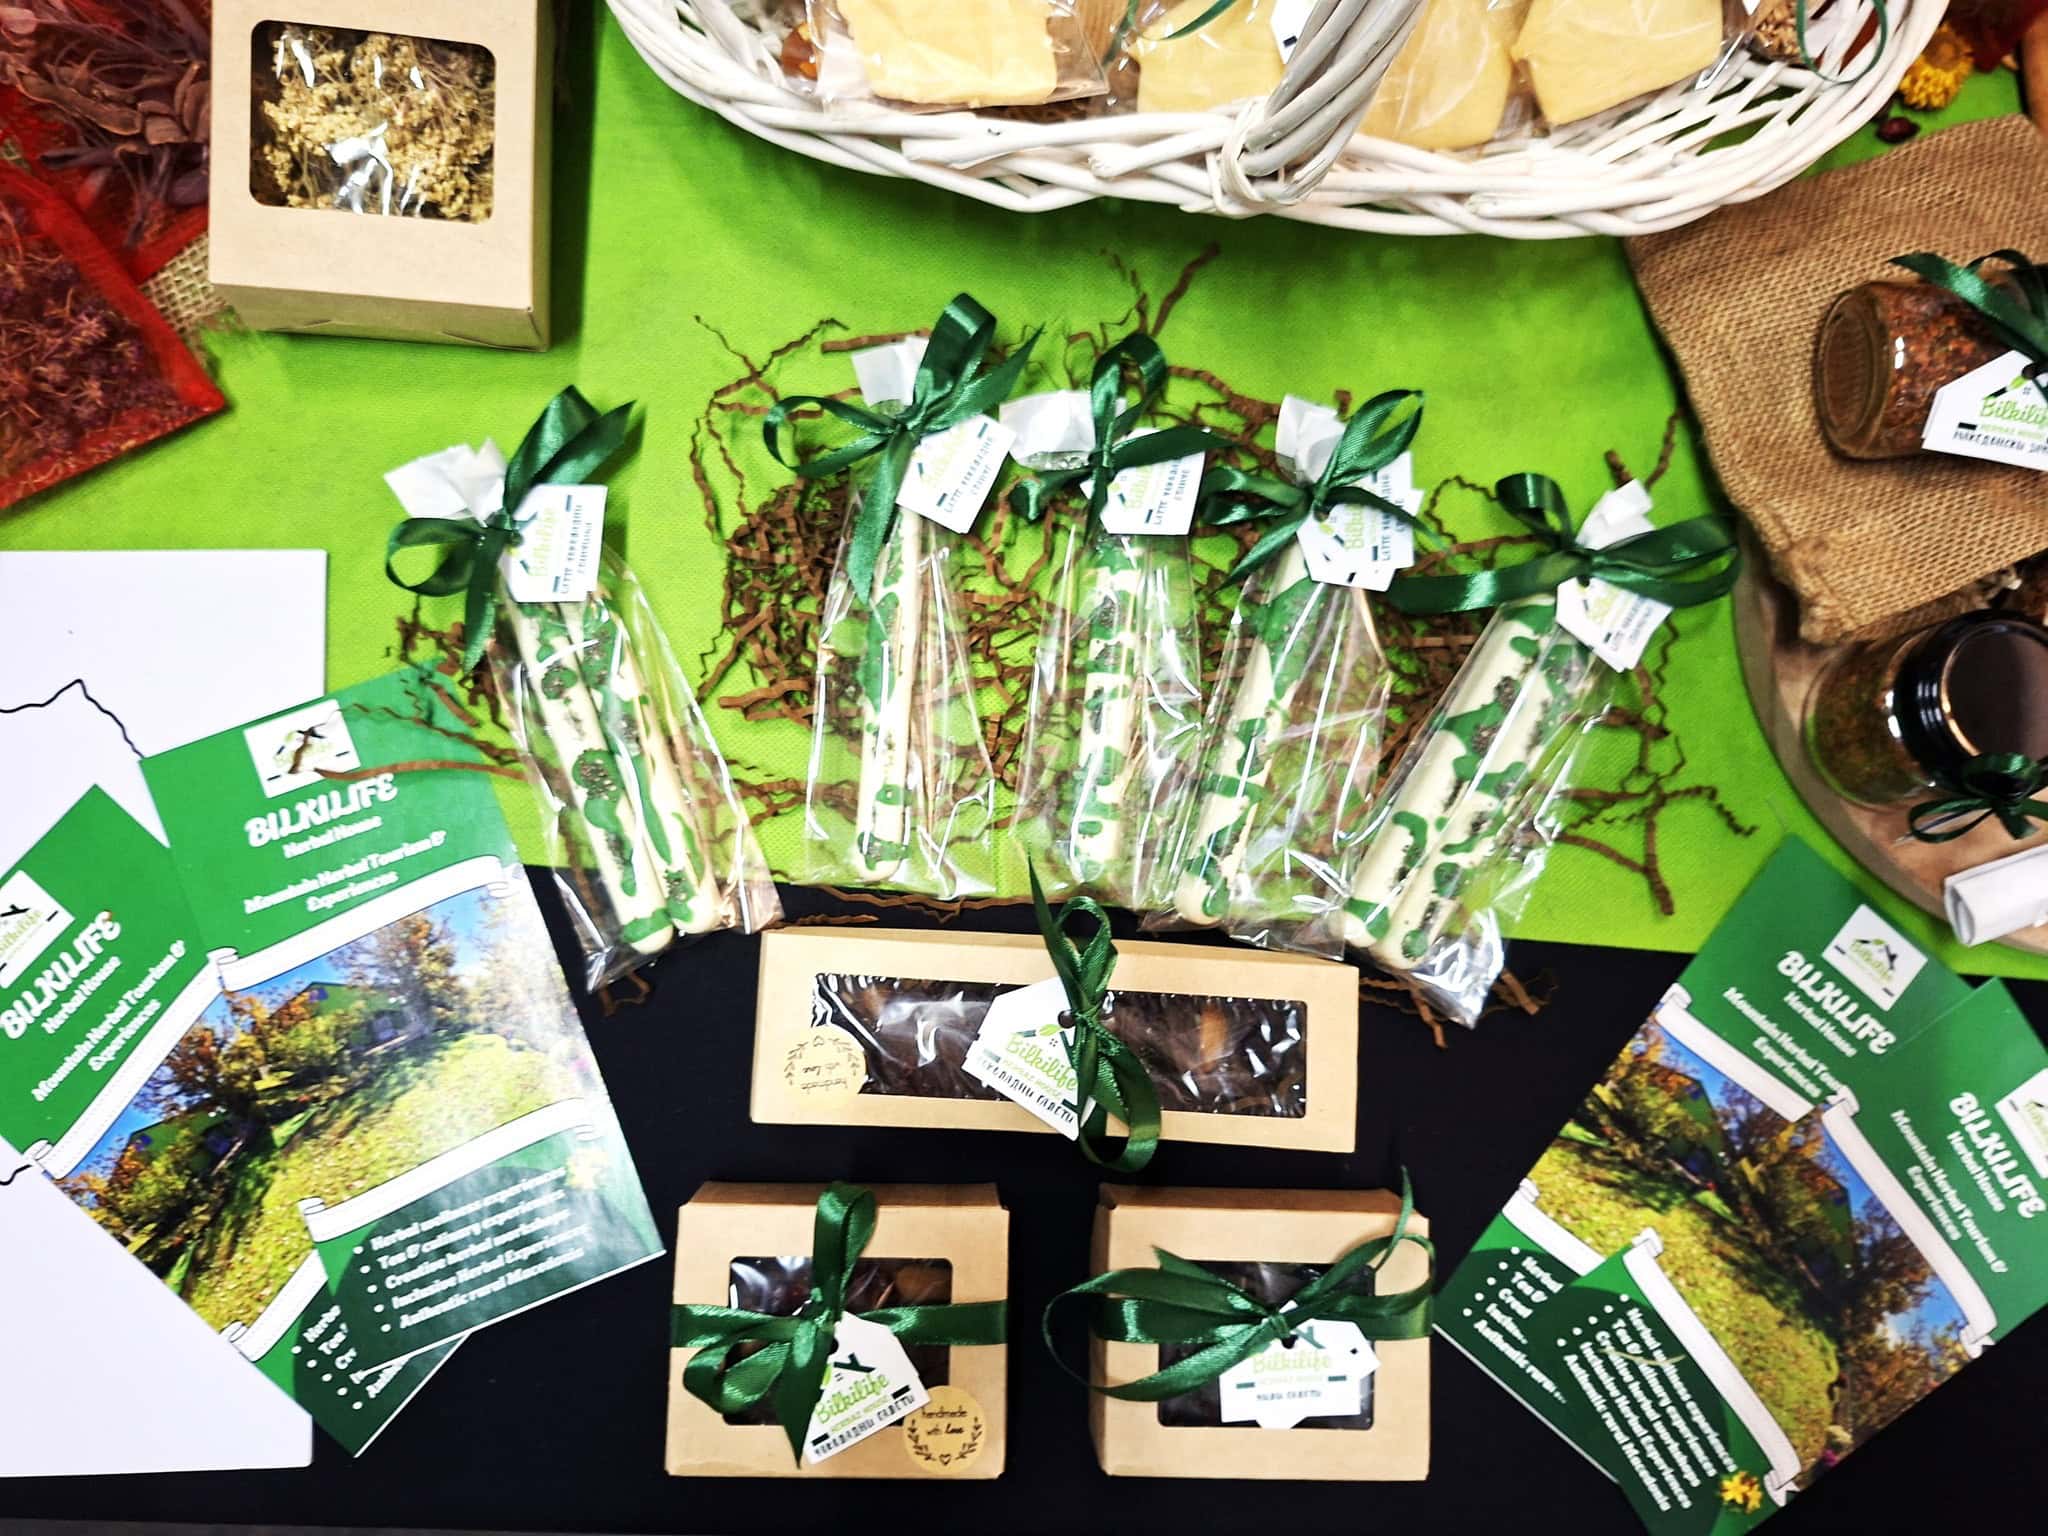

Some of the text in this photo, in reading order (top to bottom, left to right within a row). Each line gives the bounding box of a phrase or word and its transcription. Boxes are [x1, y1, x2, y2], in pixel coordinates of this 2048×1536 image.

[245, 773, 397, 846] BILKILIFE
[0, 912, 120, 1038] BILKILIFE
[42, 957, 120, 1033] Herbal House
[1778, 951, 1896, 1054] BILKILIFE
[32, 1041, 94, 1101] Mountain
[86, 1000, 131, 1044] Herbal
[123, 955, 177, 1004] Tourism
[89, 1000, 160, 1071] Experiences
[1724, 987, 1781, 1039] Mountain
[1776, 1033, 1818, 1069] Herbal
[1784, 992, 1856, 1056] Herbal House
[1005, 1034, 1078, 1092] Bilkilife
[1753, 1036, 1823, 1097] Experiences
[1891, 1110, 1937, 1172] Mountain
[1931, 1169, 1966, 1212] Herbal
[1959, 1209, 1996, 1263] Tourism
[1948, 1132, 2004, 1211] Herbal House
[1950, 1093, 2046, 1218] BILKILIFE
[371, 1222, 422, 1250] Herbal
[1907, 1166, 1961, 1241] Experiences
[1512, 1272, 1534, 1295] Tea
[1522, 1257, 1563, 1293] Herbal
[815, 1374, 890, 1424] Bilkilife
[921, 1405, 968, 1419] handmade
[944, 1422, 965, 1434] Love
[1580, 1342, 1691, 1508] Inclusive Herbal Experiences
[1613, 1319, 1632, 1344] Tea
[1634, 1357, 1671, 1406] ulinary
[1666, 1406, 1716, 1476] experiences
[1627, 1308, 1660, 1349] Herbal
[1686, 1401, 1737, 1472] experiences
[1564, 1355, 1670, 1511] Authentic rural Macedonia
[1629, 1381, 1660, 1421] herbal
[1653, 1421, 1700, 1487] workshops
